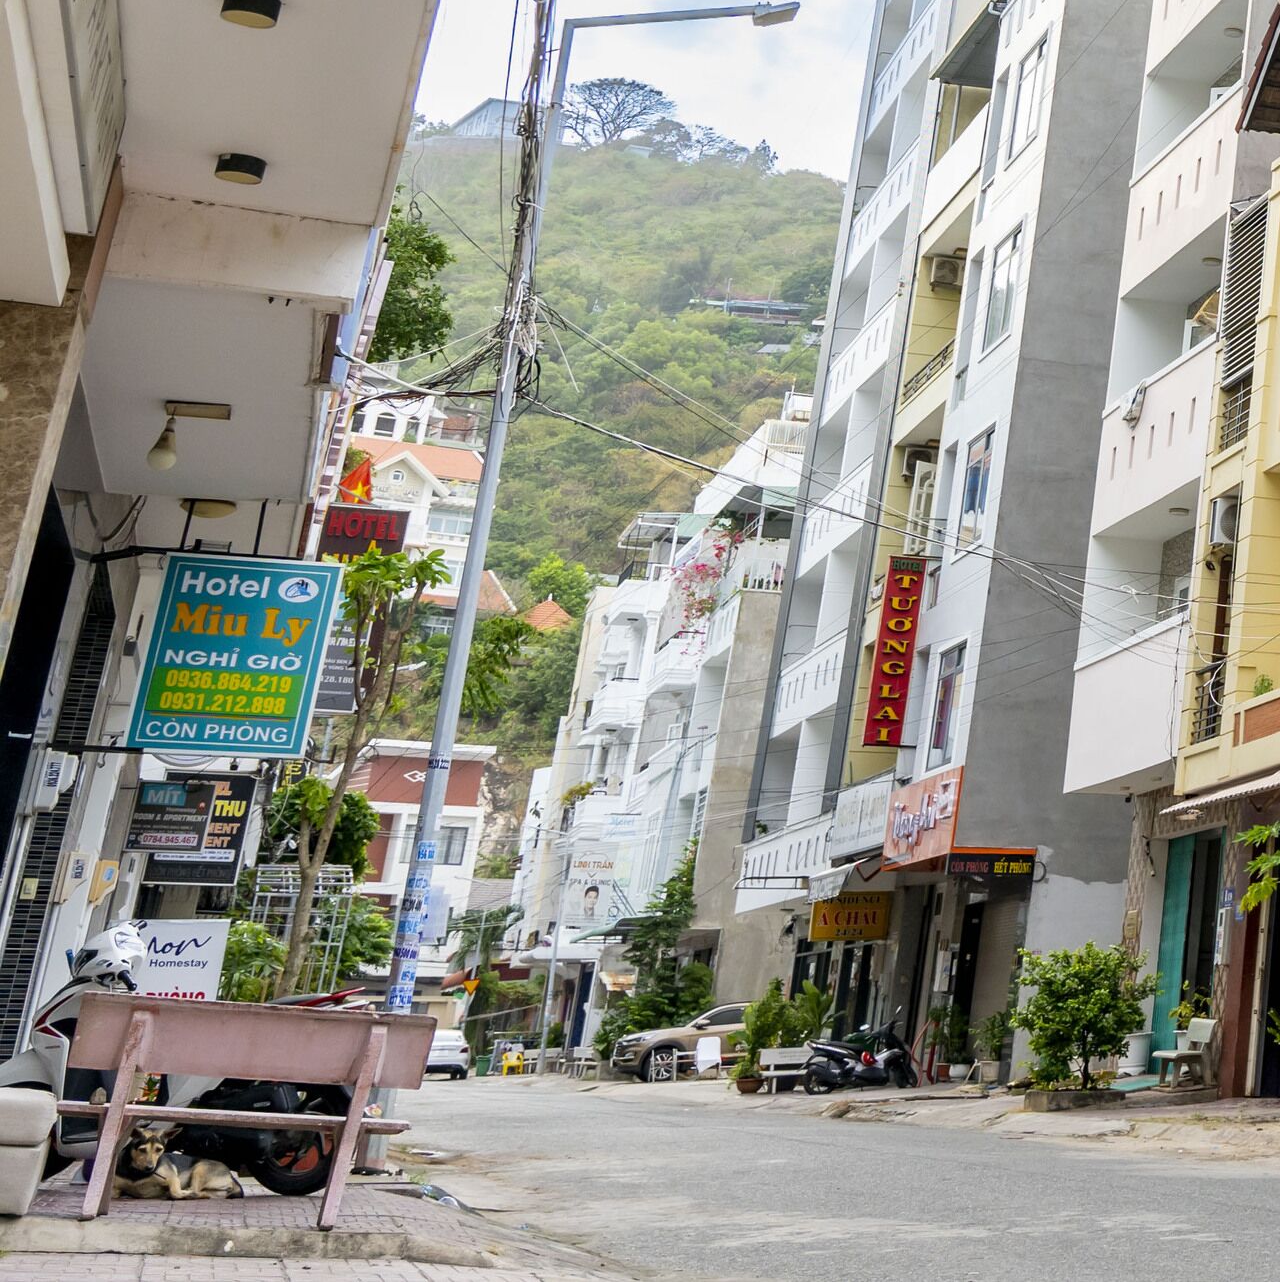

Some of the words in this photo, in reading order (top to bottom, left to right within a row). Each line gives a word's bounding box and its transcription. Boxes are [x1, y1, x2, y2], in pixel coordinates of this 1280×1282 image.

[326, 511, 399, 541] HOTEL
[892, 559, 923, 574] HOTEL
[180, 570, 271, 599] Hotel
[171, 603, 248, 637] Miu
[261, 608, 313, 647] Ly
[164, 648, 241, 668] NGHỈ
[247, 652, 303, 671] GIỜ
[166, 670, 292, 693] 0936.864.219
[160, 692, 286, 715] 0931.212.898
[146, 718, 198, 739] CÒN
[204, 721, 288, 743] PHÒNG
[215, 800, 247, 817] THU
[149, 958, 208, 969] Homestay
